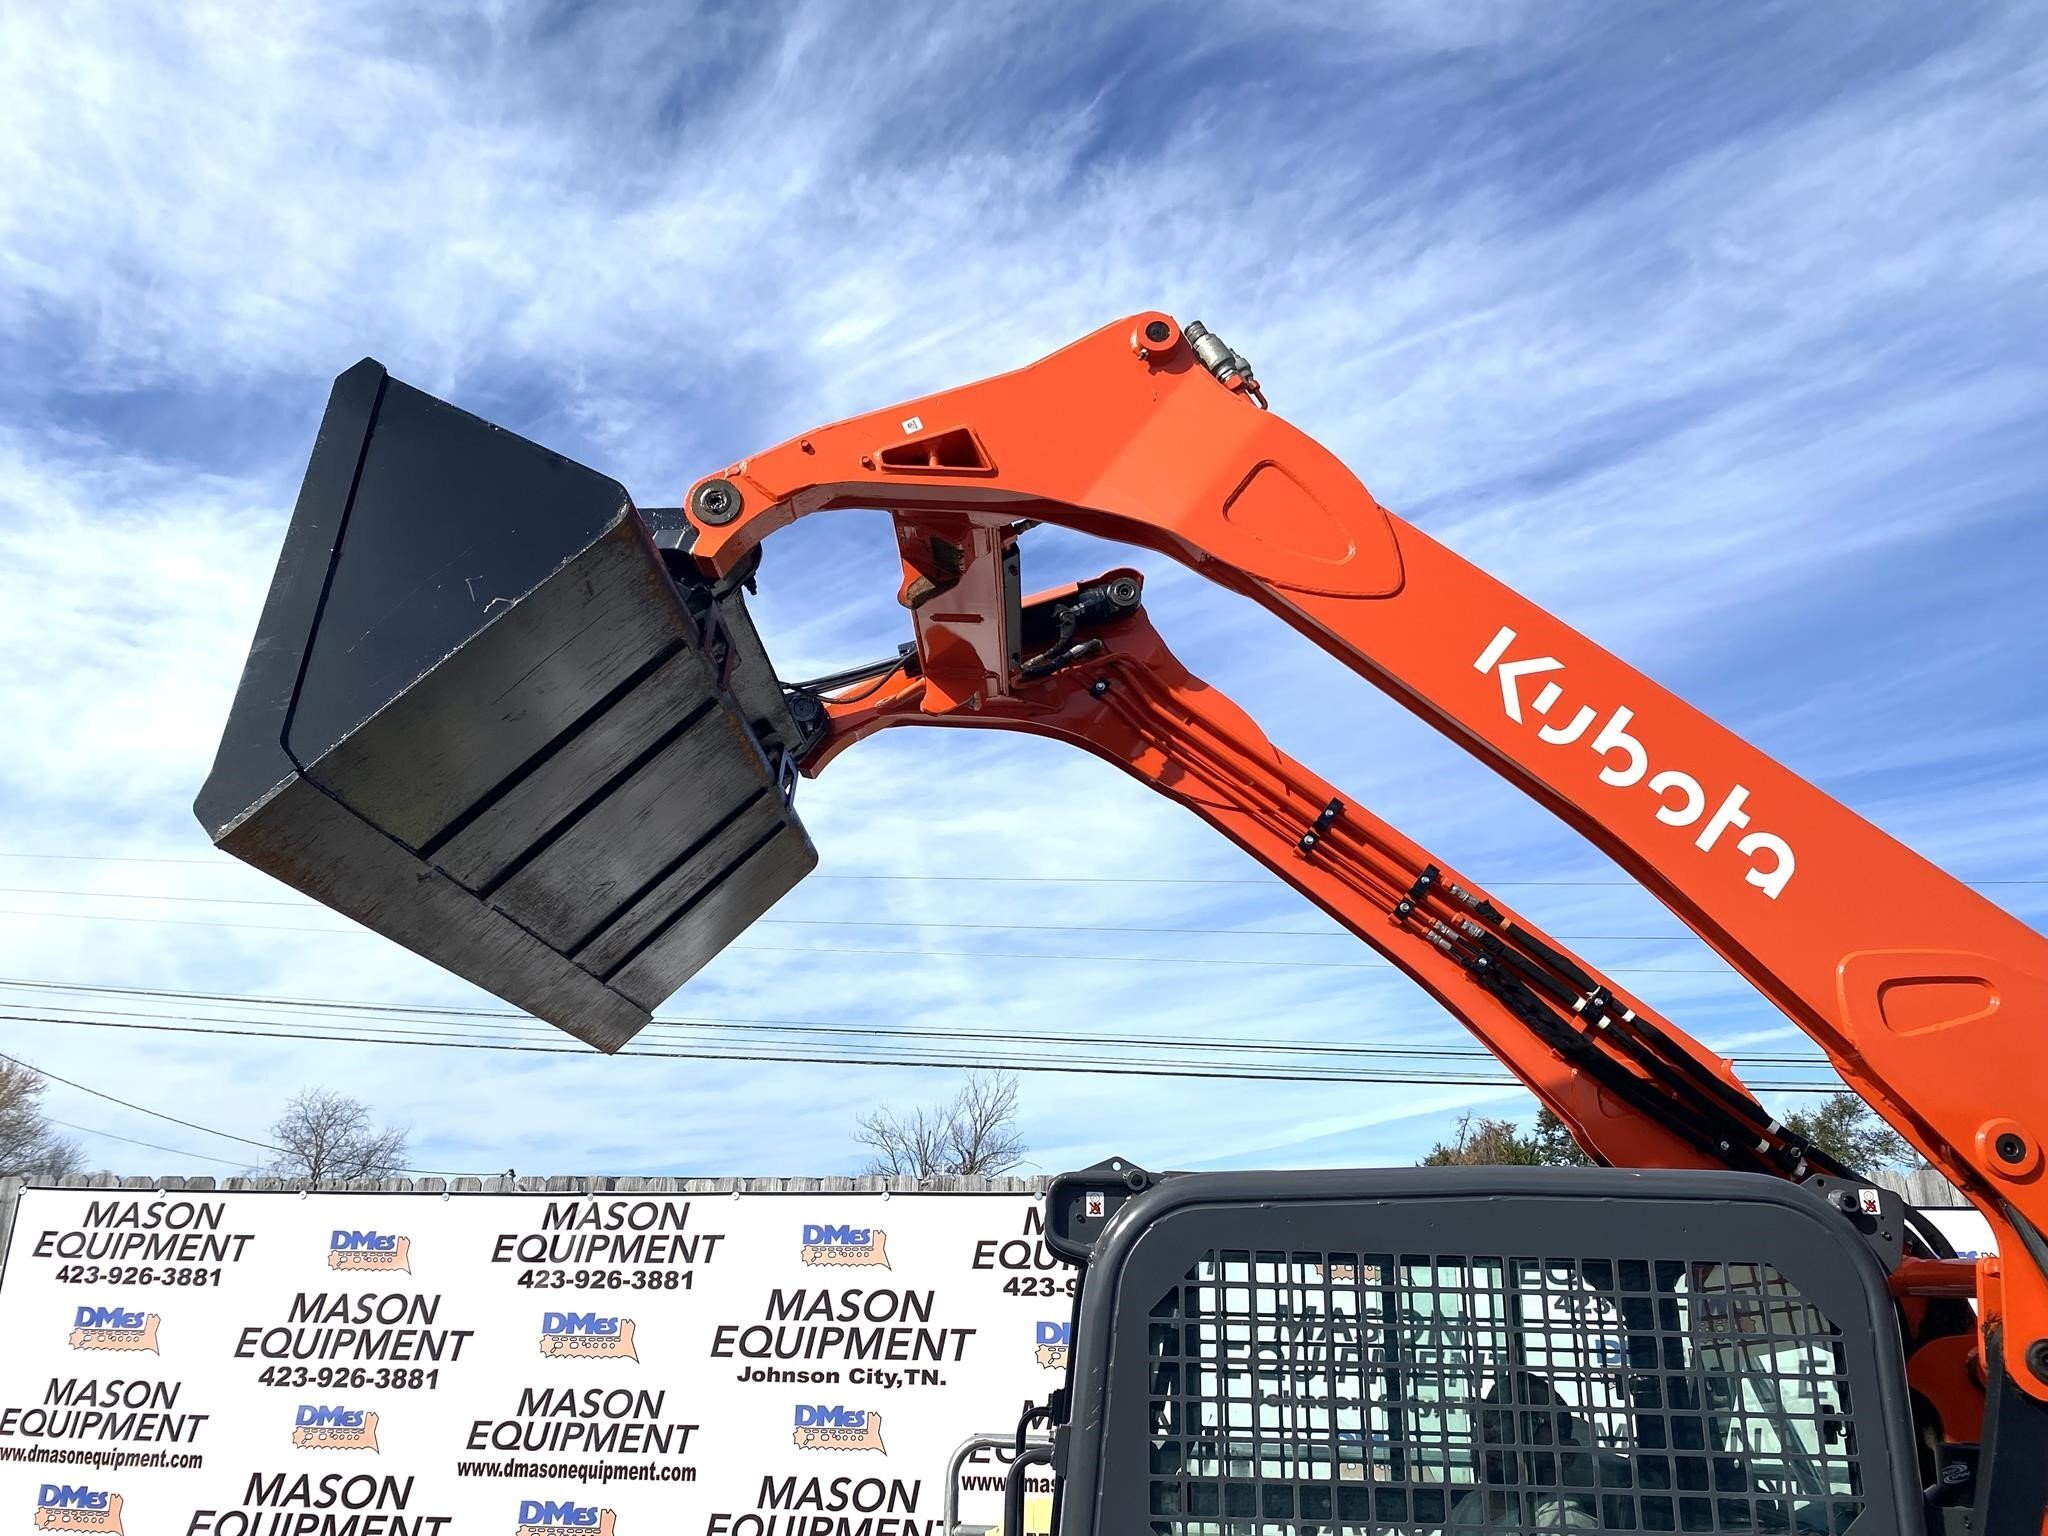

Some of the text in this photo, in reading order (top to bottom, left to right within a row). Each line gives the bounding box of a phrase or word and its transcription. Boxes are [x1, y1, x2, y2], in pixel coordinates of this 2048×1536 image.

[1473, 626, 1796, 900] Kubota
[82, 1201, 226, 1230] MASON
[541, 1201, 691, 1231] MASON
[32, 1230, 256, 1262] EQUIPMENT
[491, 1234, 726, 1264] EQUIPMENT
[55, 1264, 222, 1287] 423-926-3881
[517, 1269, 693, 1290] 423-926-3881
[287, 1292, 442, 1325] MASON
[765, 1288, 935, 1323] MASON
[233, 1326, 475, 1362] EQUIPMENT
[710, 1325, 977, 1362] EQUIPMENT
[257, 1365, 439, 1390] 423-926-3881
[736, 1366, 840, 1384] Johnson
[43, 1377, 182, 1410] MASON
[516, 1387, 666, 1420] MASON
[0, 1406, 210, 1443] EQUIPMENT
[465, 1420, 700, 1455] EQUIPMENT
[457, 1457, 697, 1485] www.dmasonequipment.com
[242, 1472, 415, 1510] MASON
[756, 1475, 922, 1514] MASON
